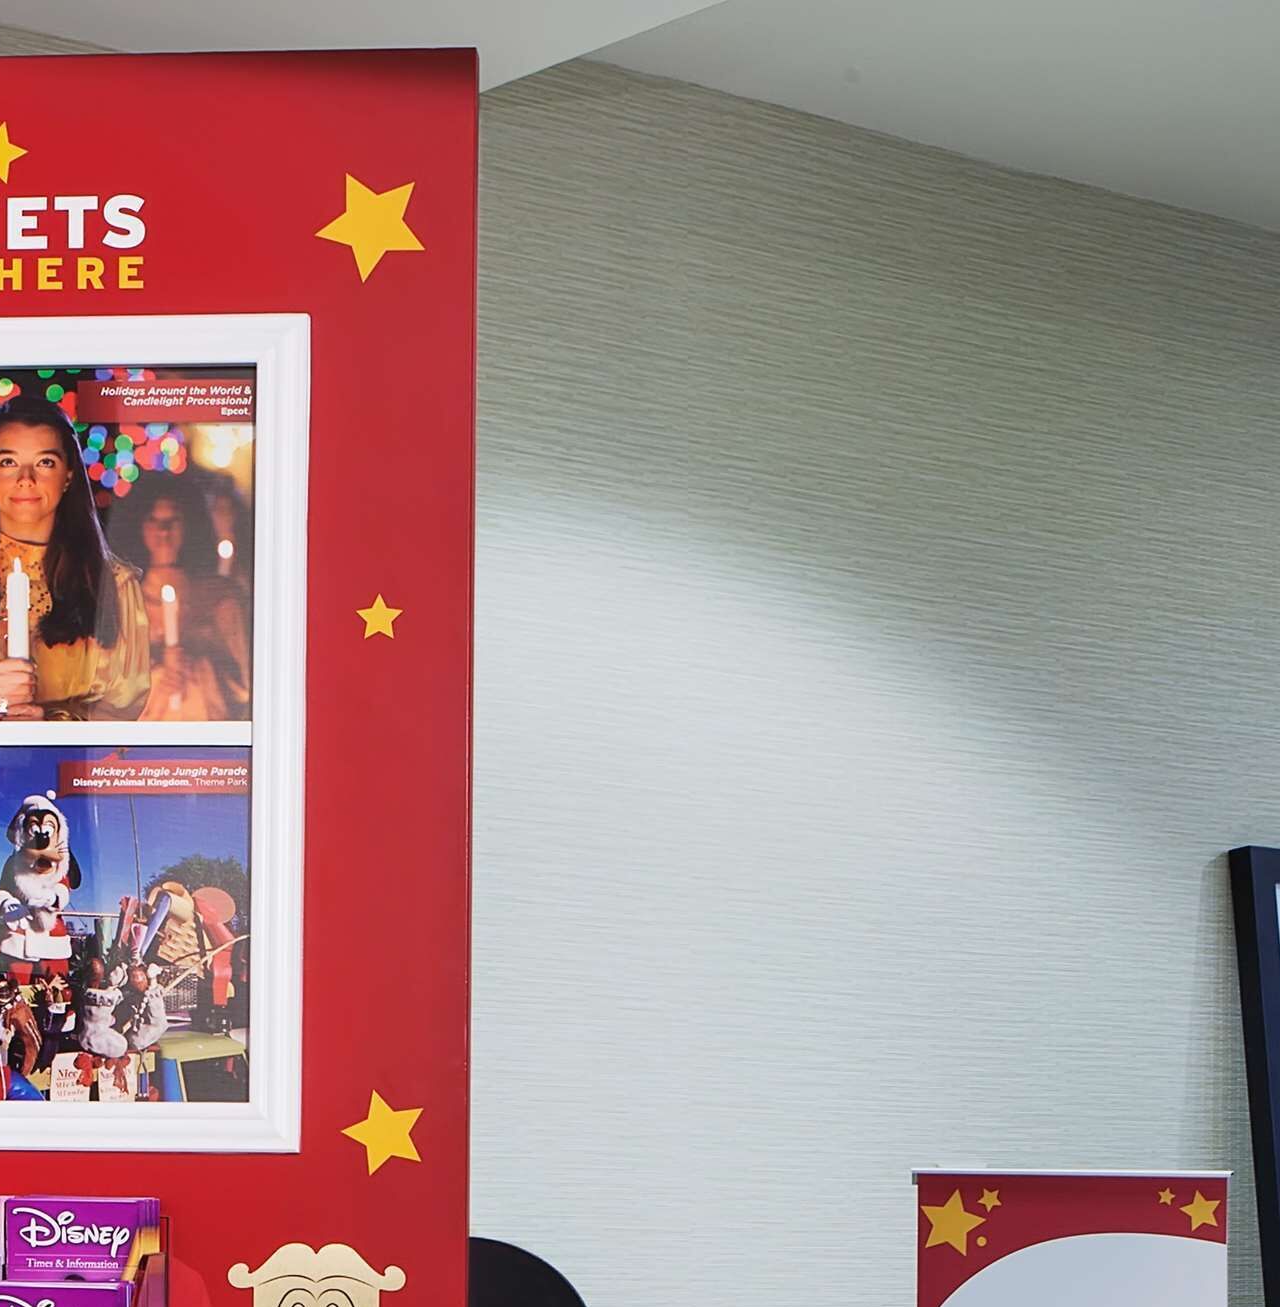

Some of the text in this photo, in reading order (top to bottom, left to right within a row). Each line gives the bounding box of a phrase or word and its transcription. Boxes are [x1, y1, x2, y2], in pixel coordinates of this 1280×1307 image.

[100, 386, 252, 397] Holidays Around the World &
[123, 395, 252, 407] Candlelight Processional
[91, 767, 247, 777] Mickey's Jingle Jungle Parade
[73, 779, 111, 788] Disney's
[113, 778, 145, 786] Animal
[12, 1207, 130, 1258] Disney
[26, 1258, 119, 1269] Times & Information
